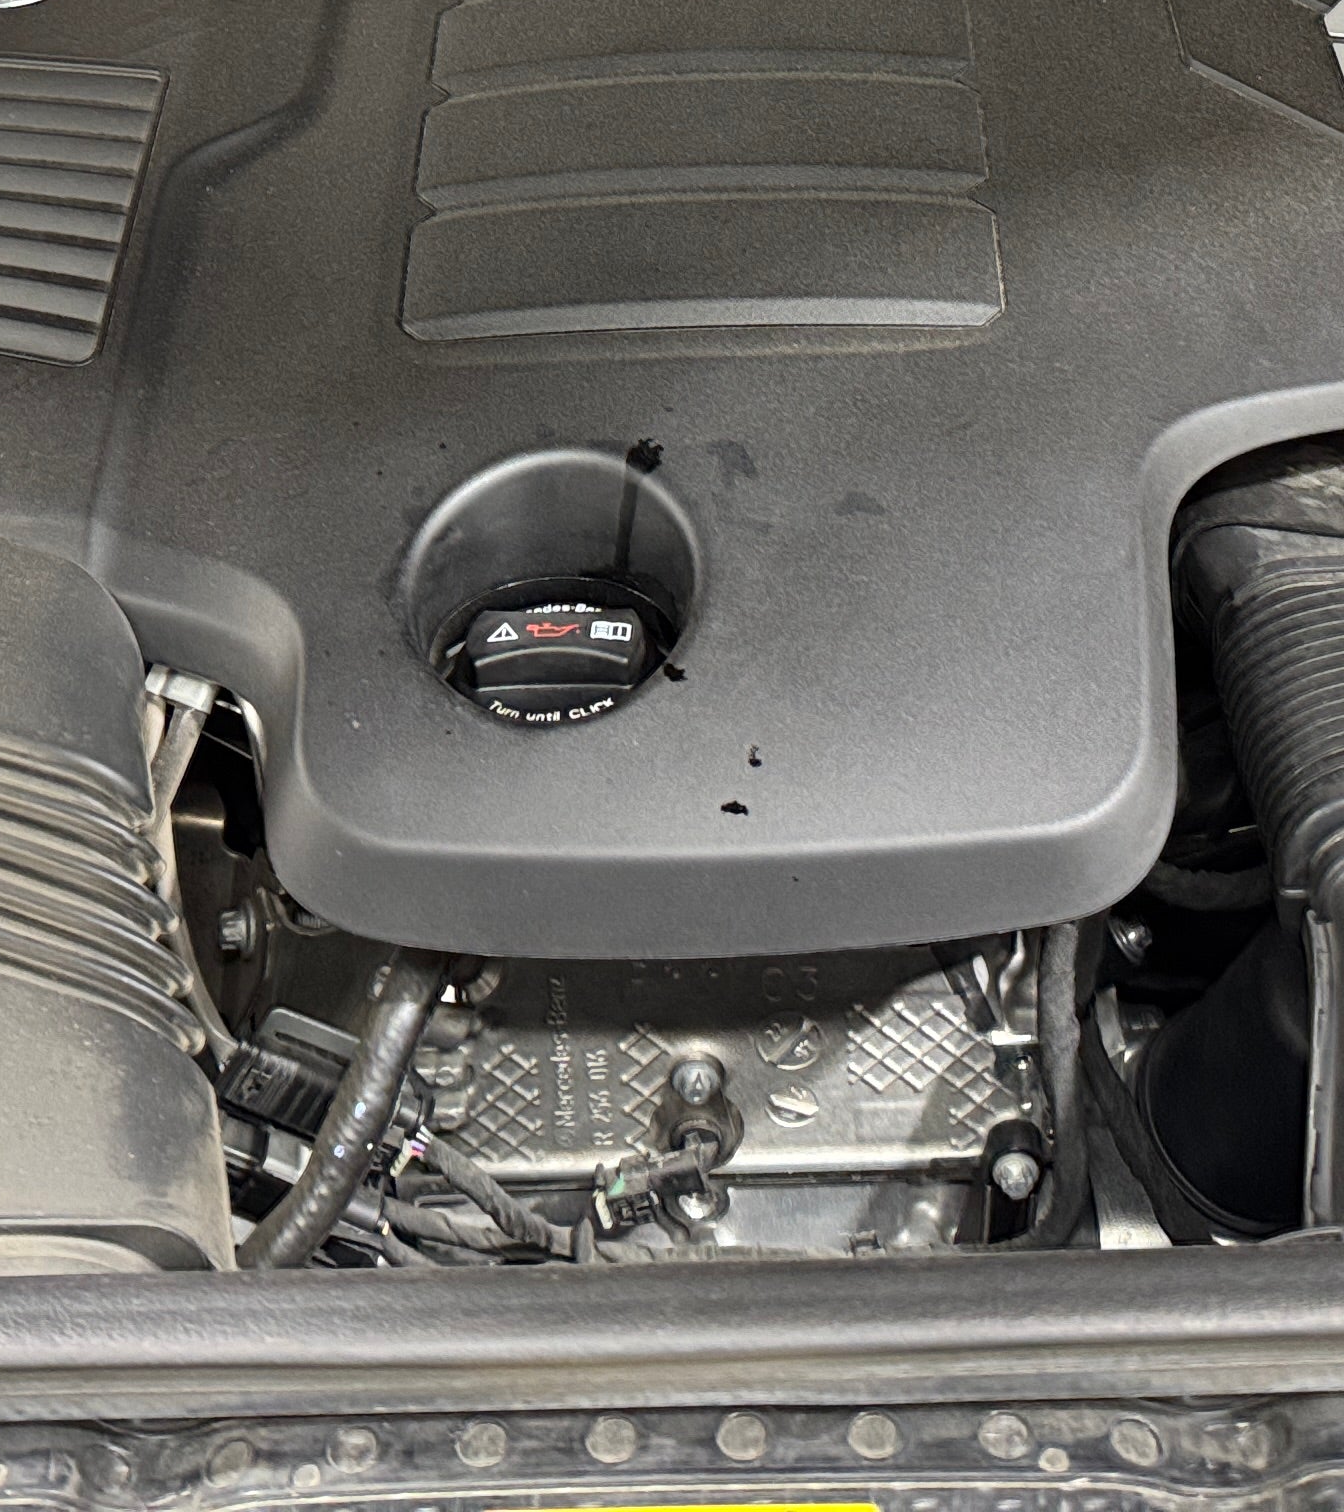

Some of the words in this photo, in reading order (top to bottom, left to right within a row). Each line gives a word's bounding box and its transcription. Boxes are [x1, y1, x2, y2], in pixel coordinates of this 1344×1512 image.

[488, 699, 520, 720] Turn
[526, 710, 561, 722] until
[568, 696, 615, 720] CLICK
